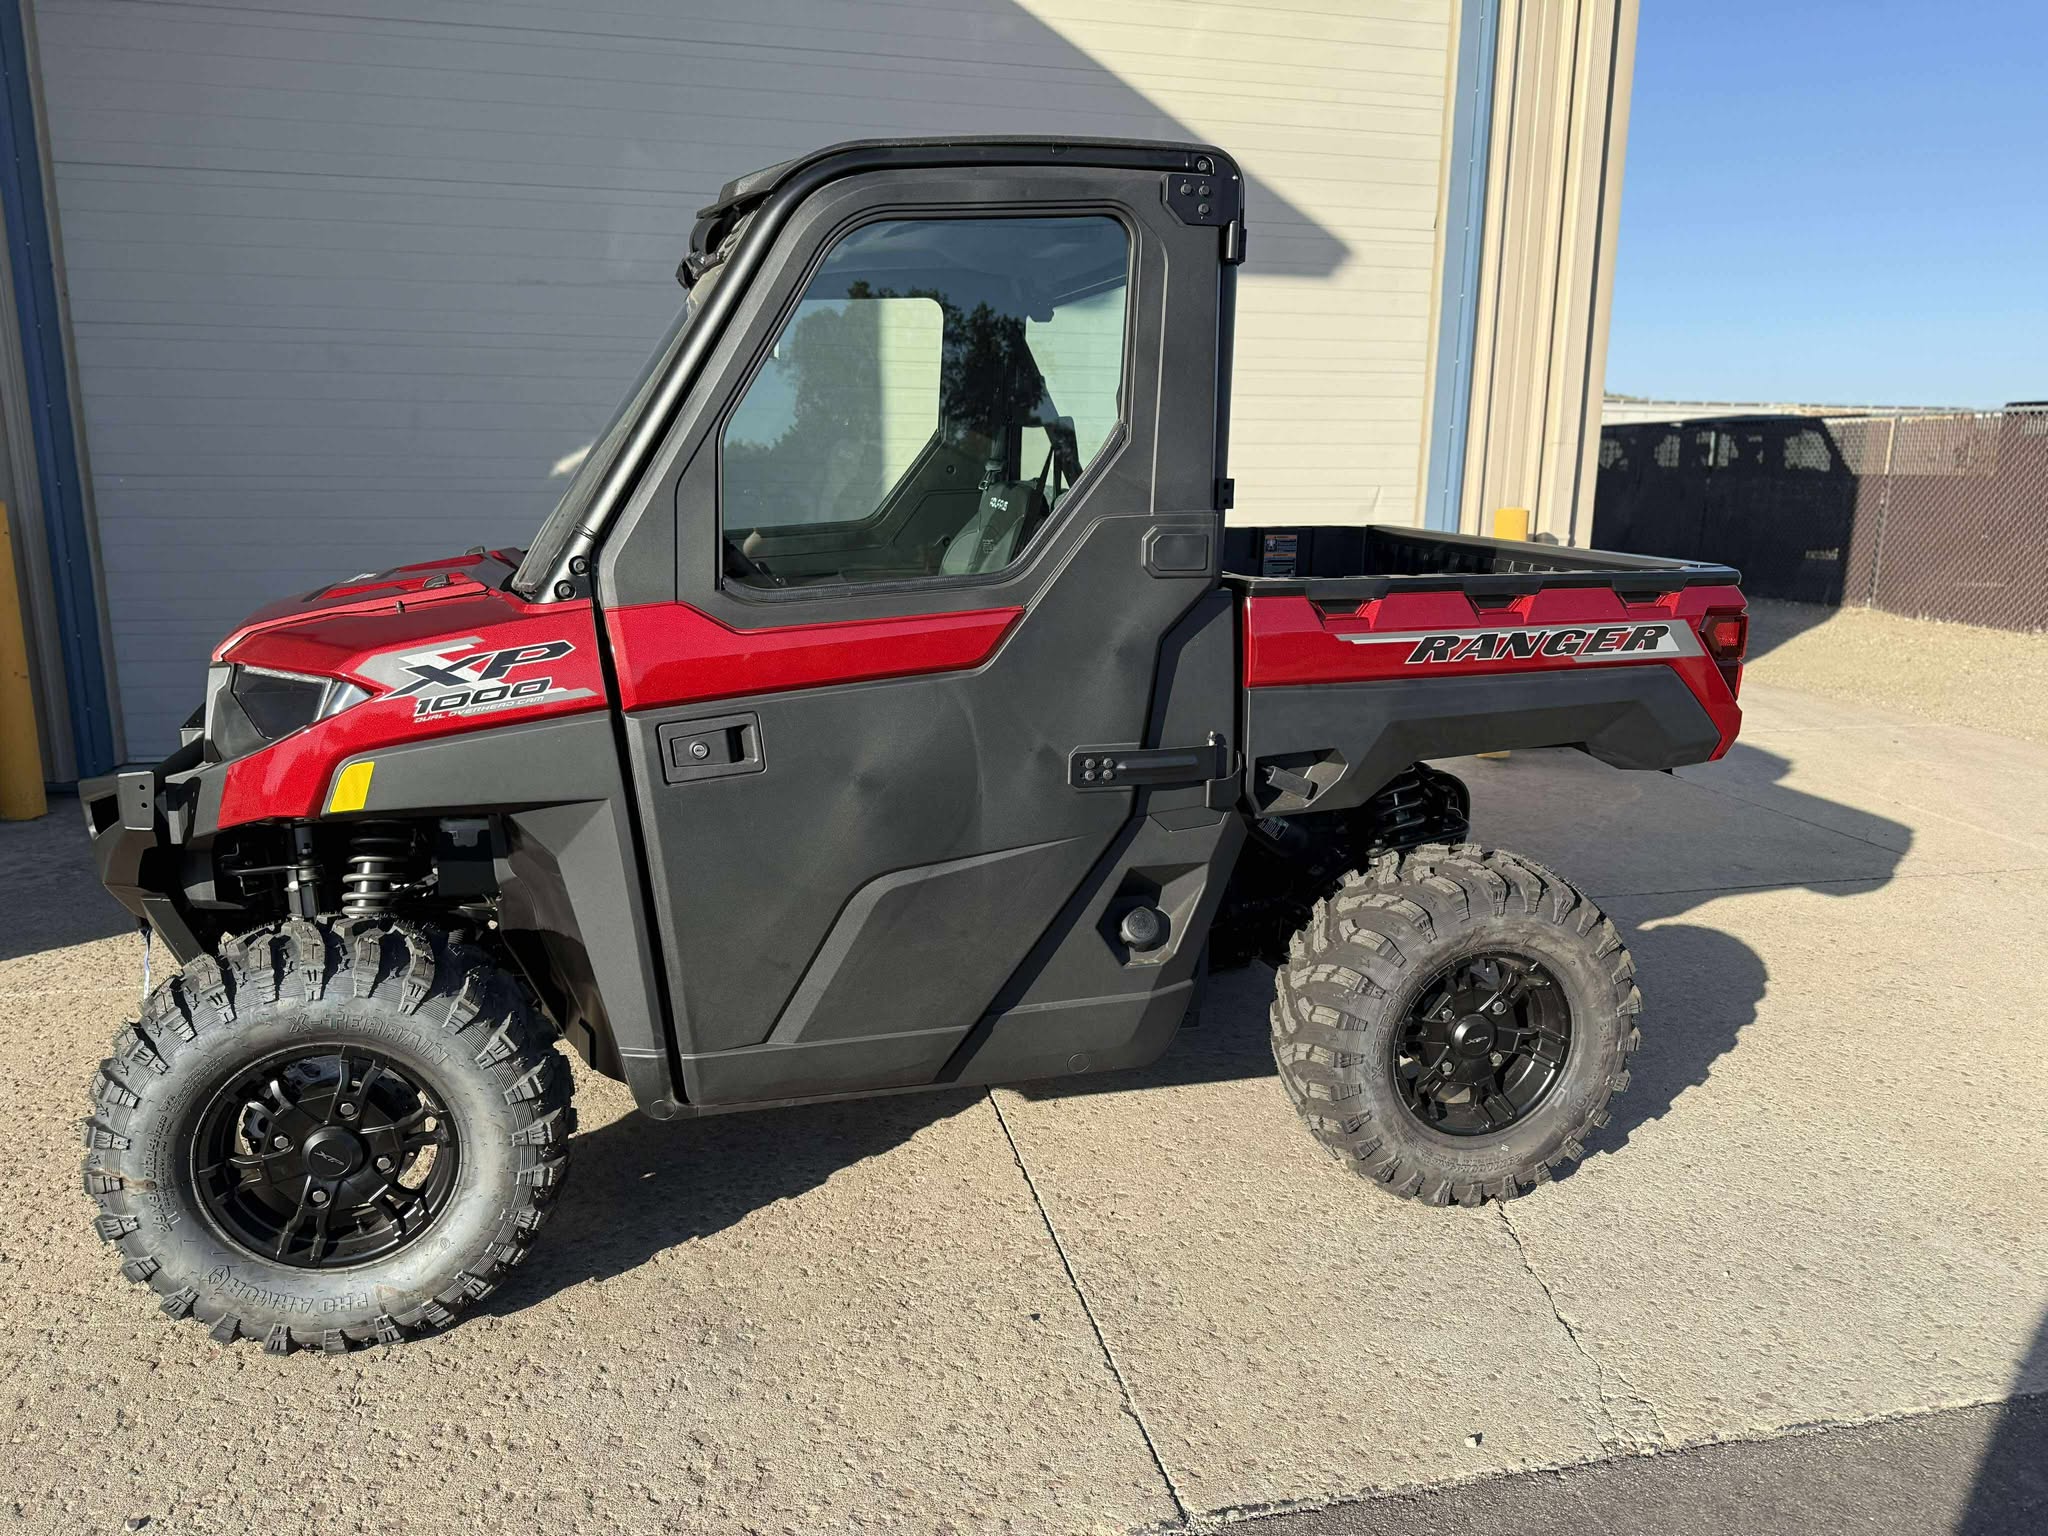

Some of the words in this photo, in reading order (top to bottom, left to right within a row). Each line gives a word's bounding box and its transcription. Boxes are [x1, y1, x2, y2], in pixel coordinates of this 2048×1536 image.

[1405, 624, 1670, 664] RANGER
[377, 639, 576, 701] XP
[413, 678, 552, 717] 1000
[413, 712, 447, 724] DUAL
[448, 702, 516, 717] OVERHEAD
[516, 695, 545, 706] CAM
[287, 1012, 449, 1066] X-TERRAIN
[231, 1277, 315, 1314] ARMOR
[317, 1291, 369, 1315] PRO
